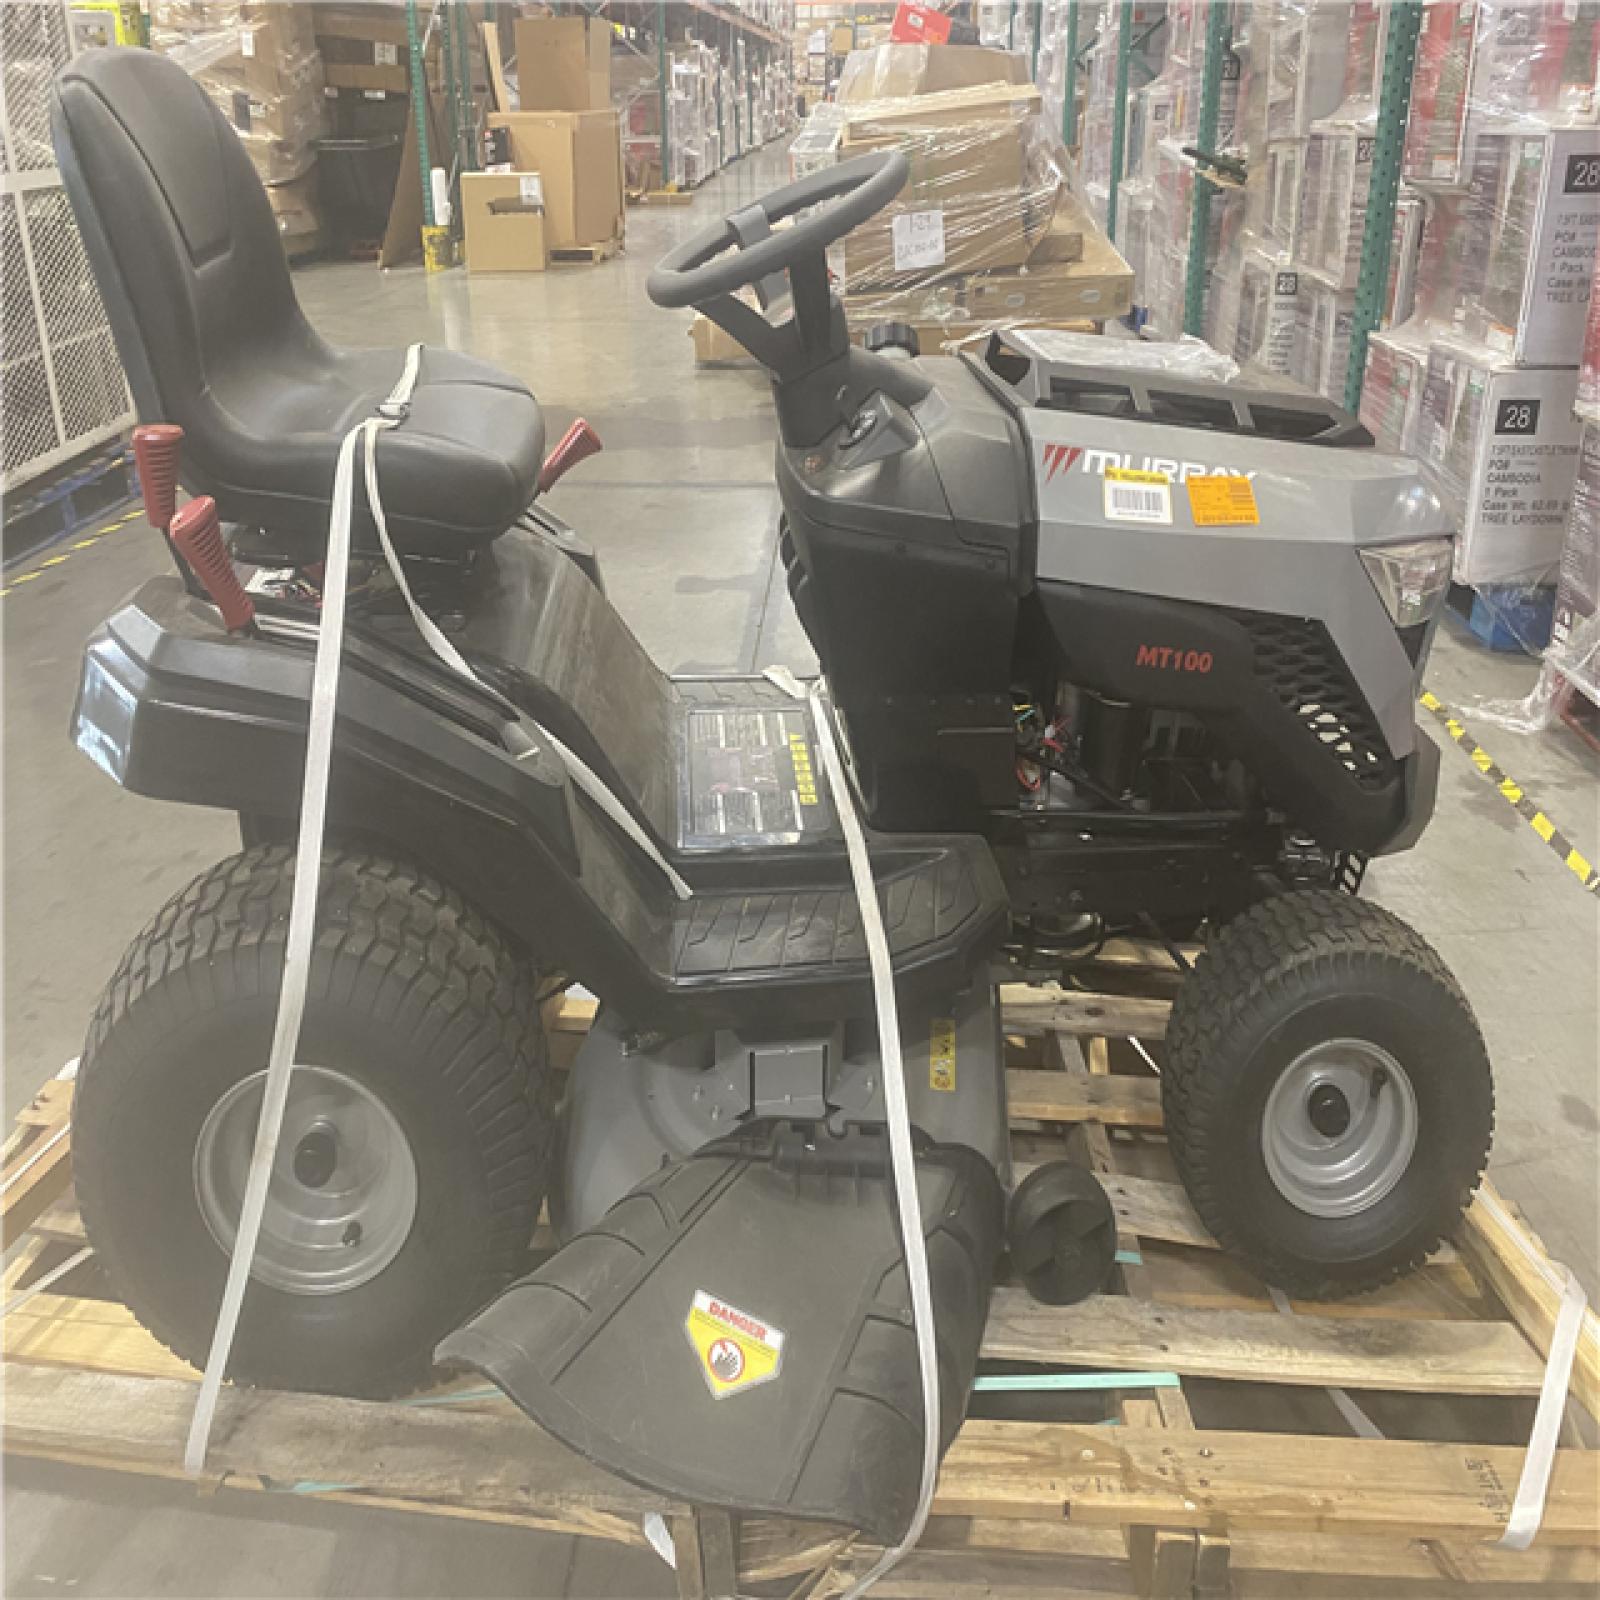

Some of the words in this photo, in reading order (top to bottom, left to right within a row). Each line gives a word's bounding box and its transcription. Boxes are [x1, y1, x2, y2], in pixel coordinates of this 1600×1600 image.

[1504, 405, 1531, 428] 28
[1135, 643, 1215, 674] MT100
[709, 1301, 766, 1341] DANGER
